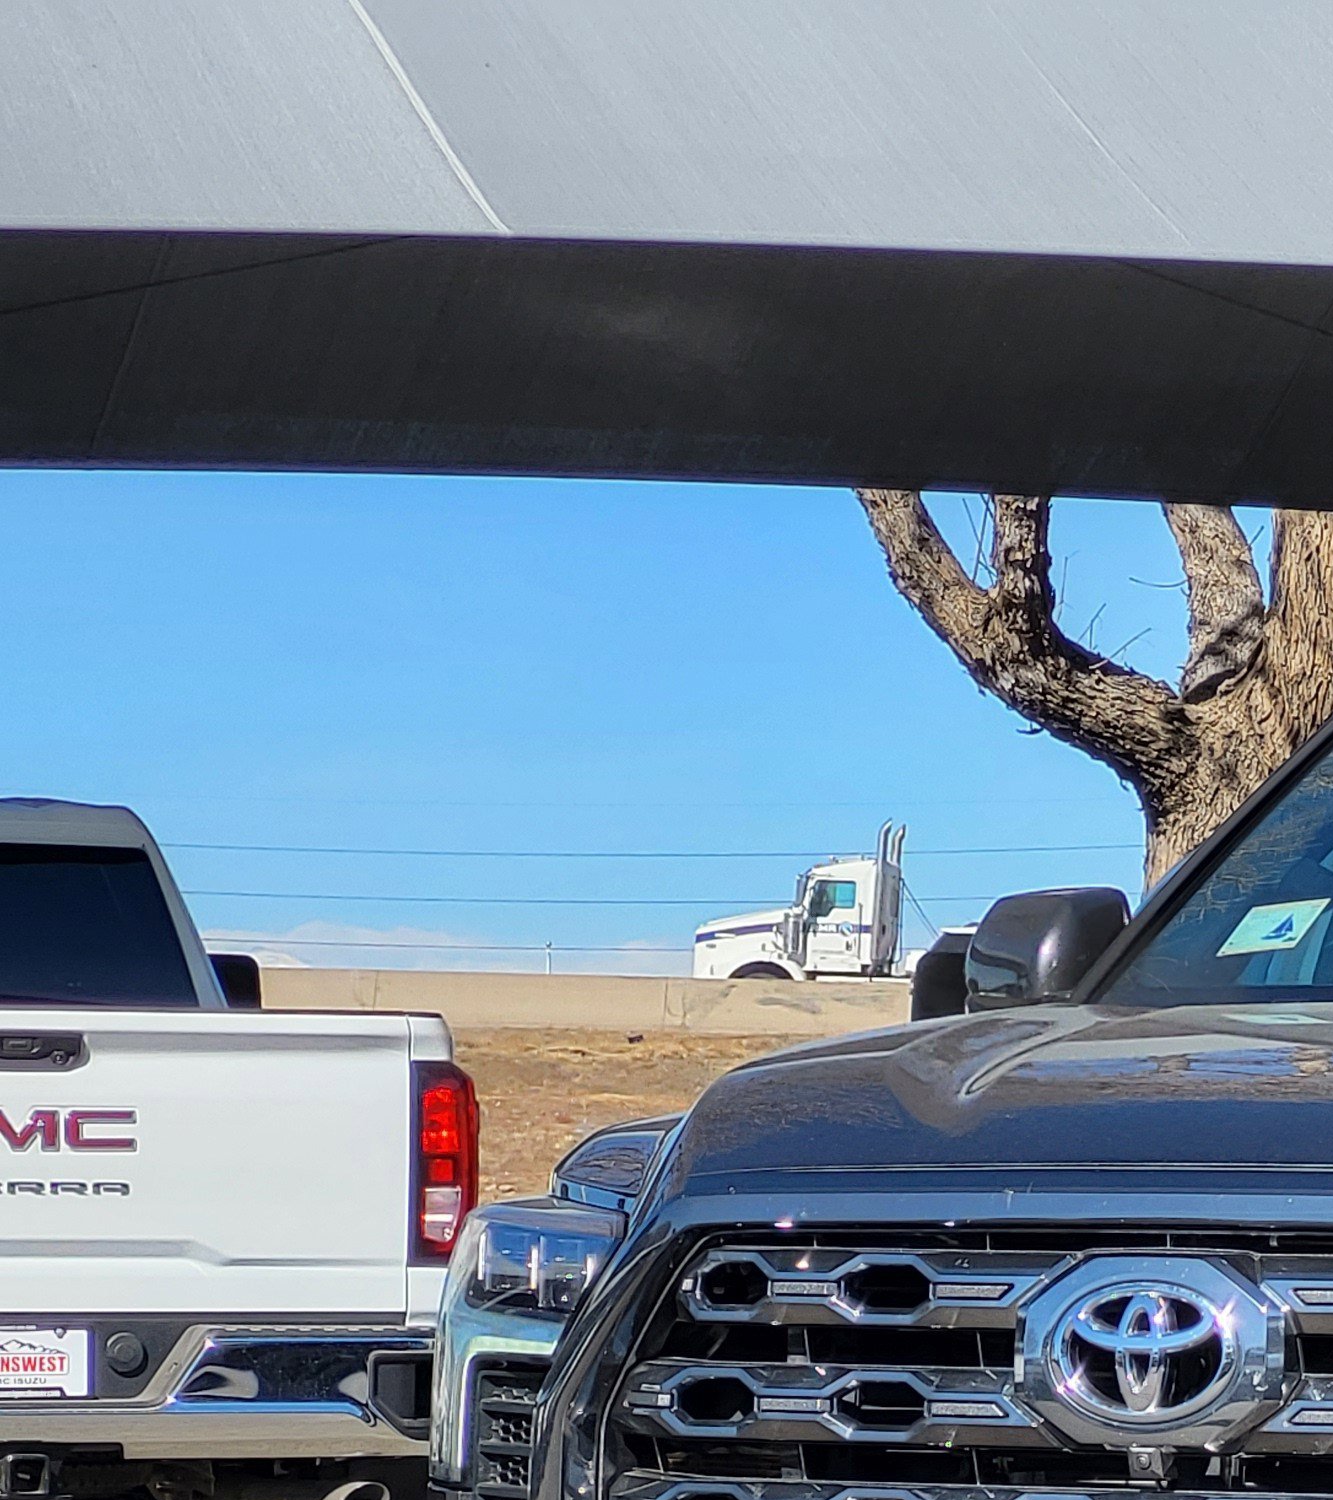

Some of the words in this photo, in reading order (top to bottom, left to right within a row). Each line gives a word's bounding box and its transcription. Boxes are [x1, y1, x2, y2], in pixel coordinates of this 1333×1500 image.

[0, 1109, 138, 1152] MC
[0, 1181, 130, 1196] RRA
[0, 1356, 67, 1372] NSWEST
